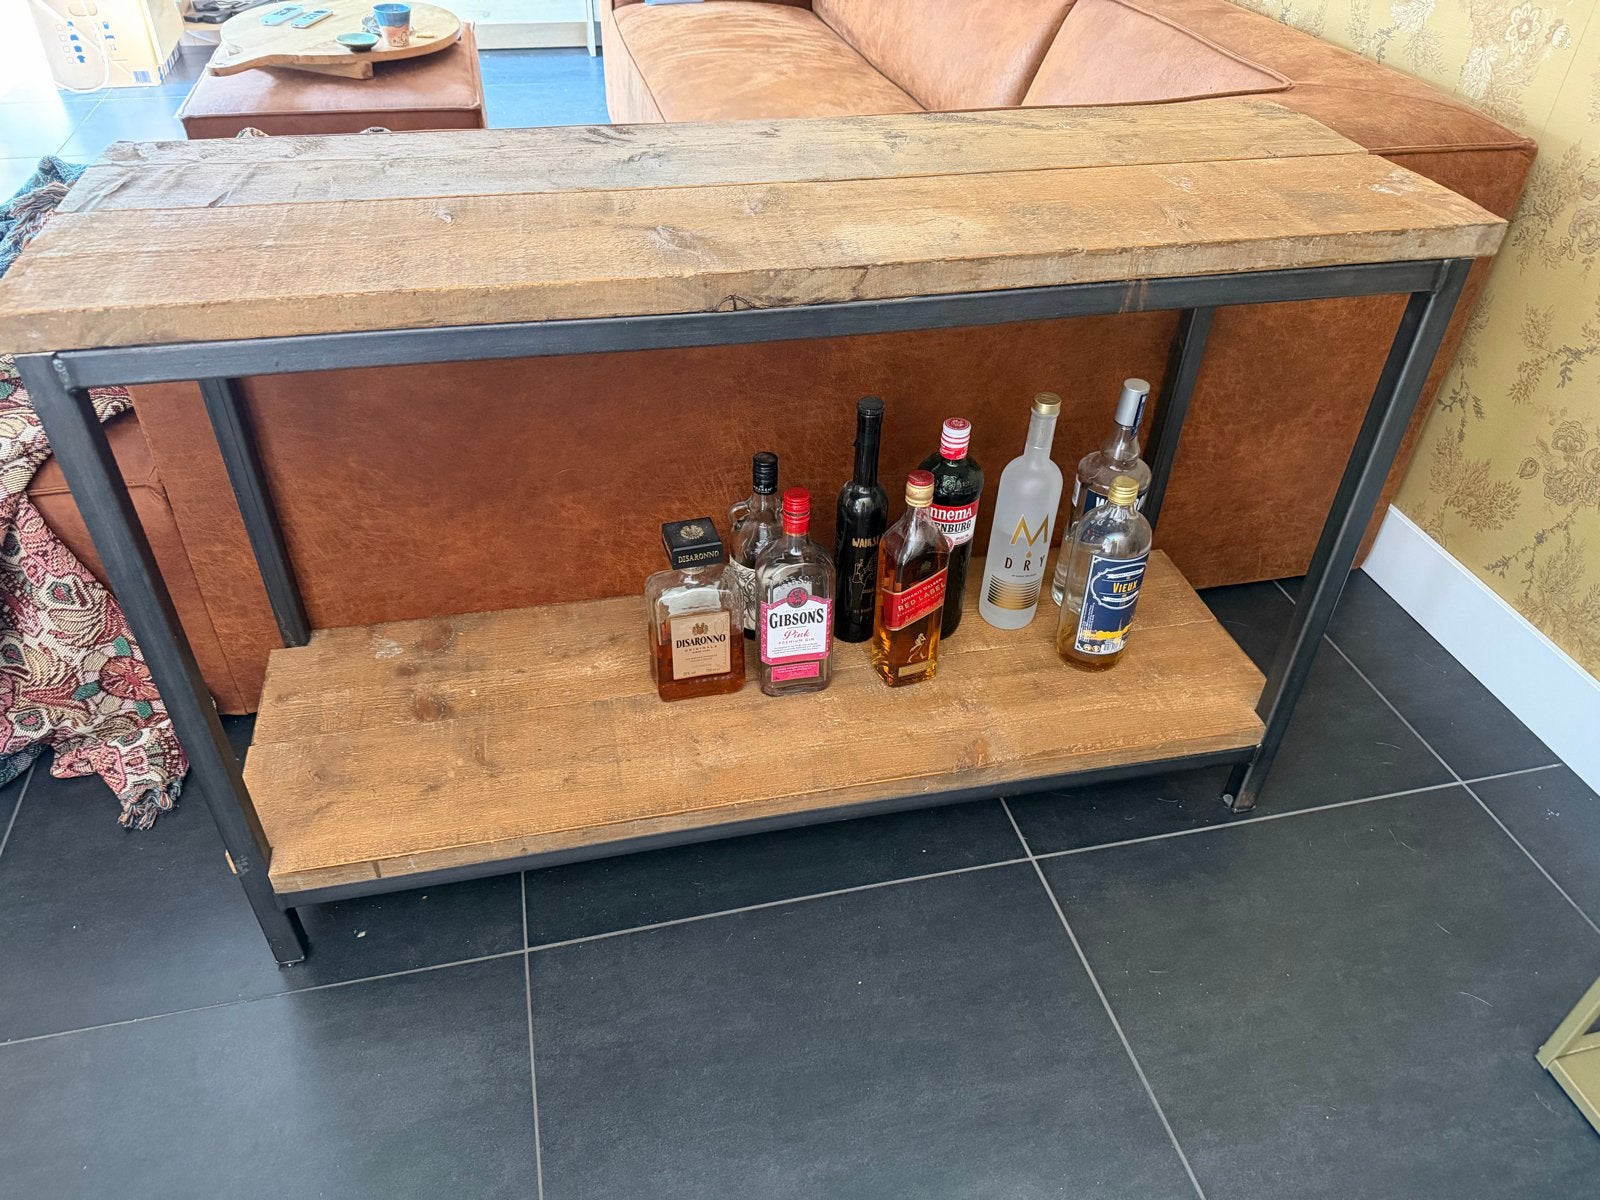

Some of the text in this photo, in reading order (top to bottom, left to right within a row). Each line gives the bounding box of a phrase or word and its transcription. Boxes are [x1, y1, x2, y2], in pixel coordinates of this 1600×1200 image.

[935, 520, 972, 533] ENBURG
[1010, 513, 1049, 546] M
[678, 550, 720, 564] DISARONNO
[1004, 554, 1046, 571] DRY
[897, 600, 916, 612] RED
[918, 582, 946, 600] LABEL
[769, 608, 824, 629] GIBSON'S
[676, 634, 726, 649] DISARONNO
[783, 629, 810, 640] Pink
